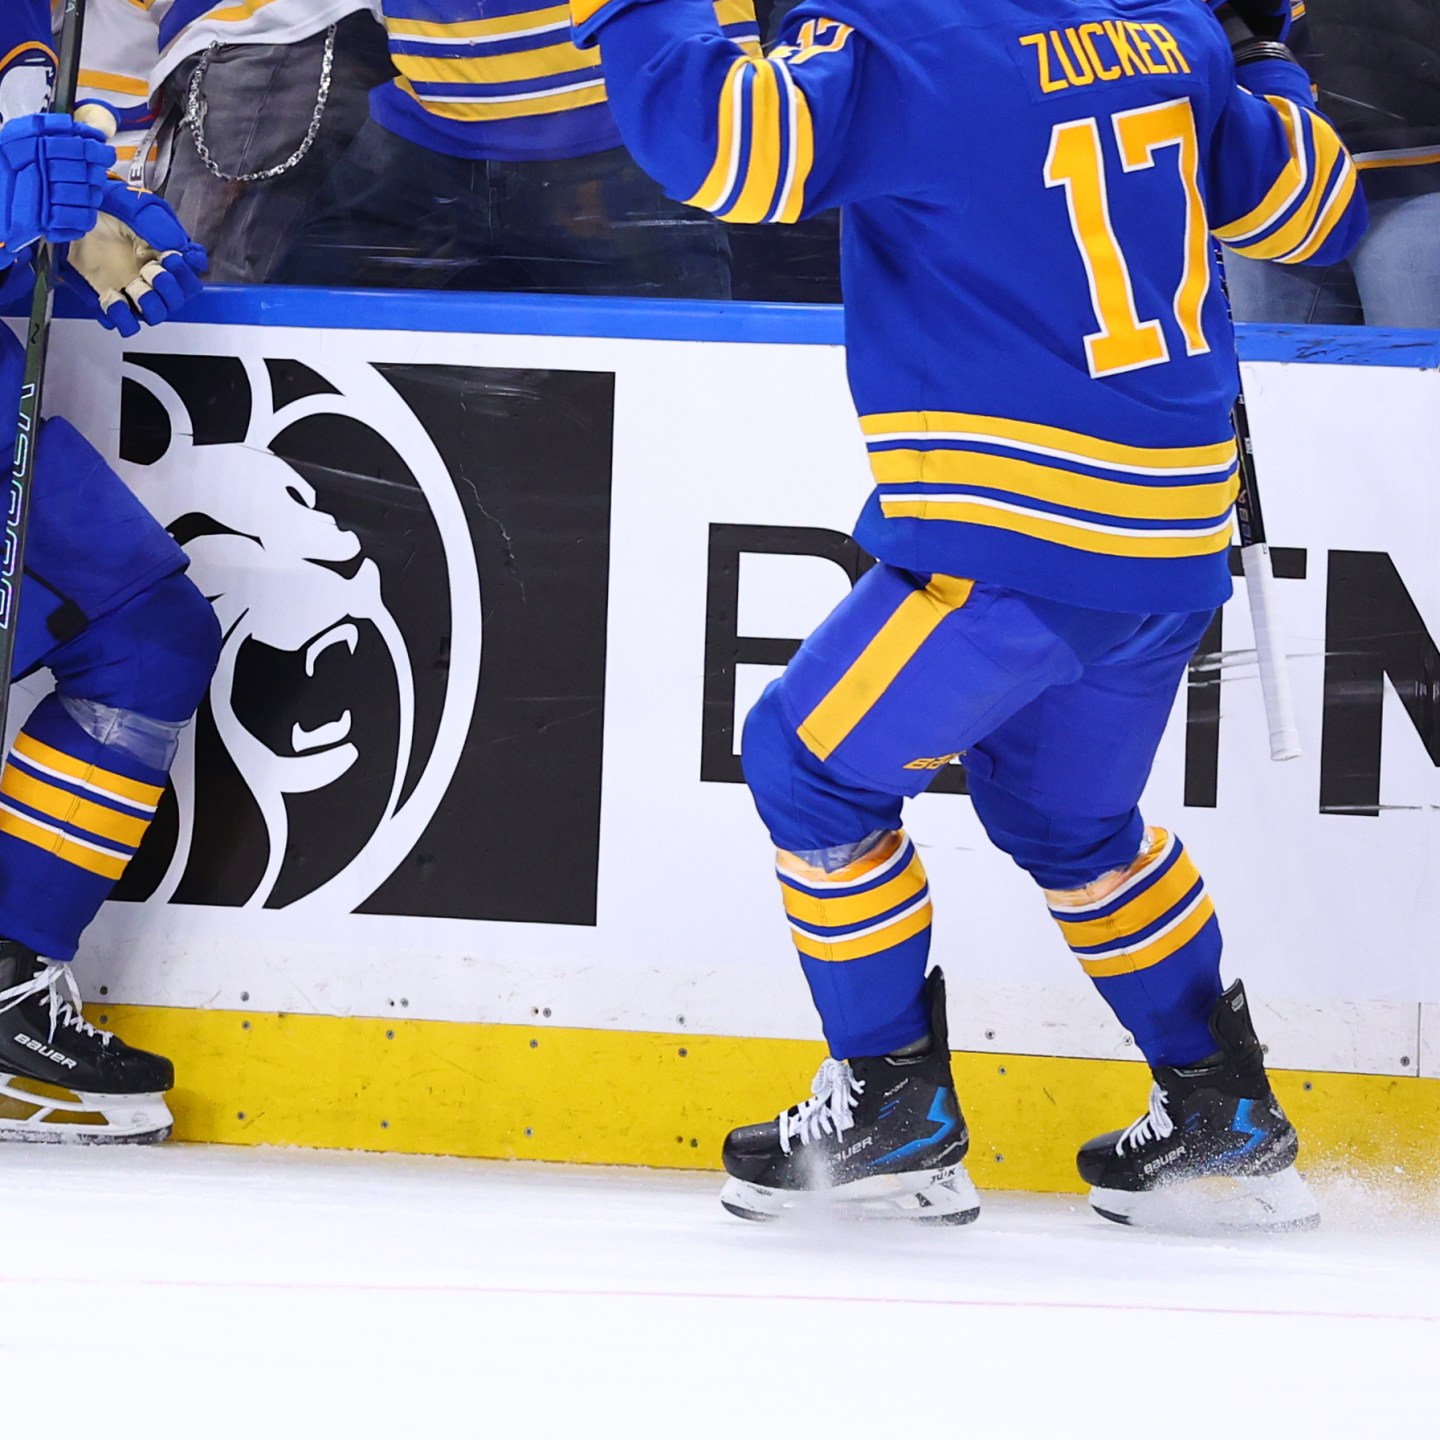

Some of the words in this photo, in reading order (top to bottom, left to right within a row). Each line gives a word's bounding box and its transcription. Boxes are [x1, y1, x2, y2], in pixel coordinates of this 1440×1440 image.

[1019, 20, 1192, 95] ZUCKER
[1043, 97, 1212, 379] 17
[13, 1033, 78, 1069] BAUER
[1143, 1145, 1187, 1175] BAUER
